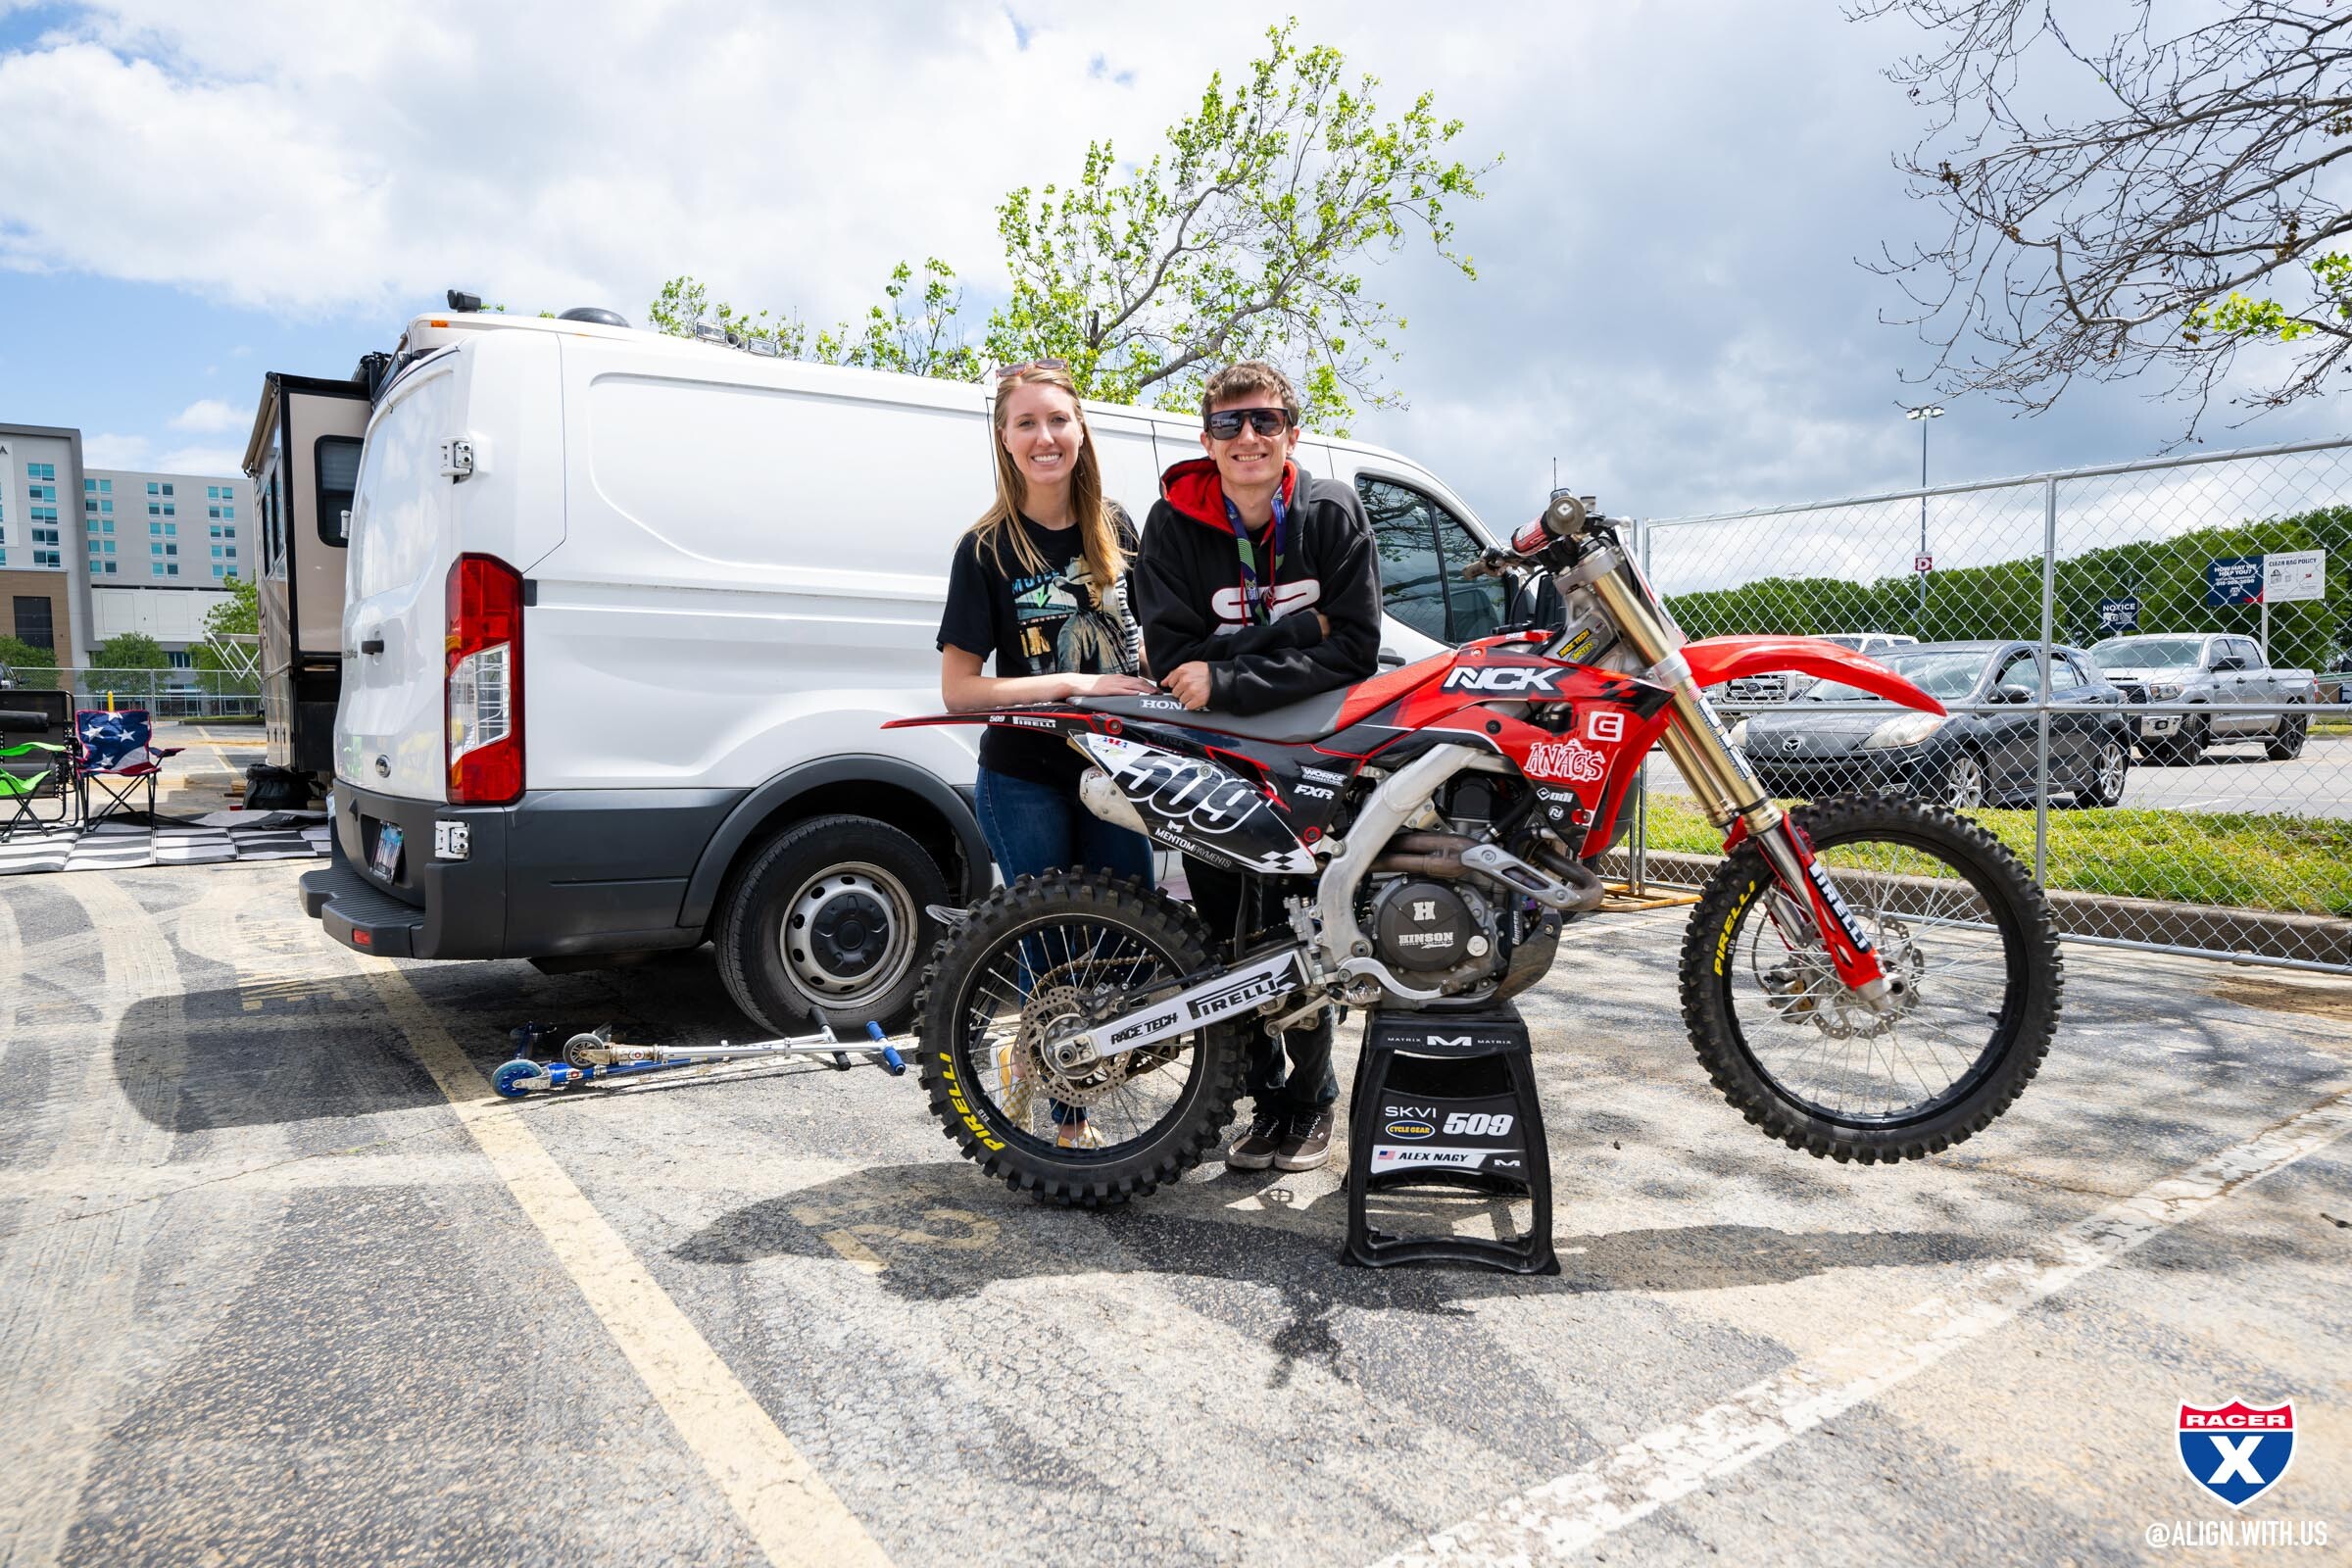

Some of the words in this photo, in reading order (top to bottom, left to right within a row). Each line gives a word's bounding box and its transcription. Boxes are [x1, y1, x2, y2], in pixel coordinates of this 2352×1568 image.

[1917, 557, 1929, 569] D
[1443, 666, 1565, 692] NCK
[1012, 716, 1056, 728] PIRELLI
[1302, 767, 1347, 781] WORKS
[1112, 750, 1277, 833] 509
[1294, 783, 1335, 800] FXR
[1398, 932, 1453, 945] HINSON
[1714, 880, 1755, 977] PIRELLI
[1186, 971, 1277, 1020] PIRELLI
[1110, 1022, 1144, 1046] RACE
[1146, 1011, 1178, 1033] TECH
[939, 1052, 1005, 1152] PIRELLI
[1385, 1106, 1437, 1118] SKVI
[1442, 1112, 1514, 1137] 509
[1398, 1152, 1430, 1161] ALEX
[1433, 1152, 1468, 1162] NAGY
